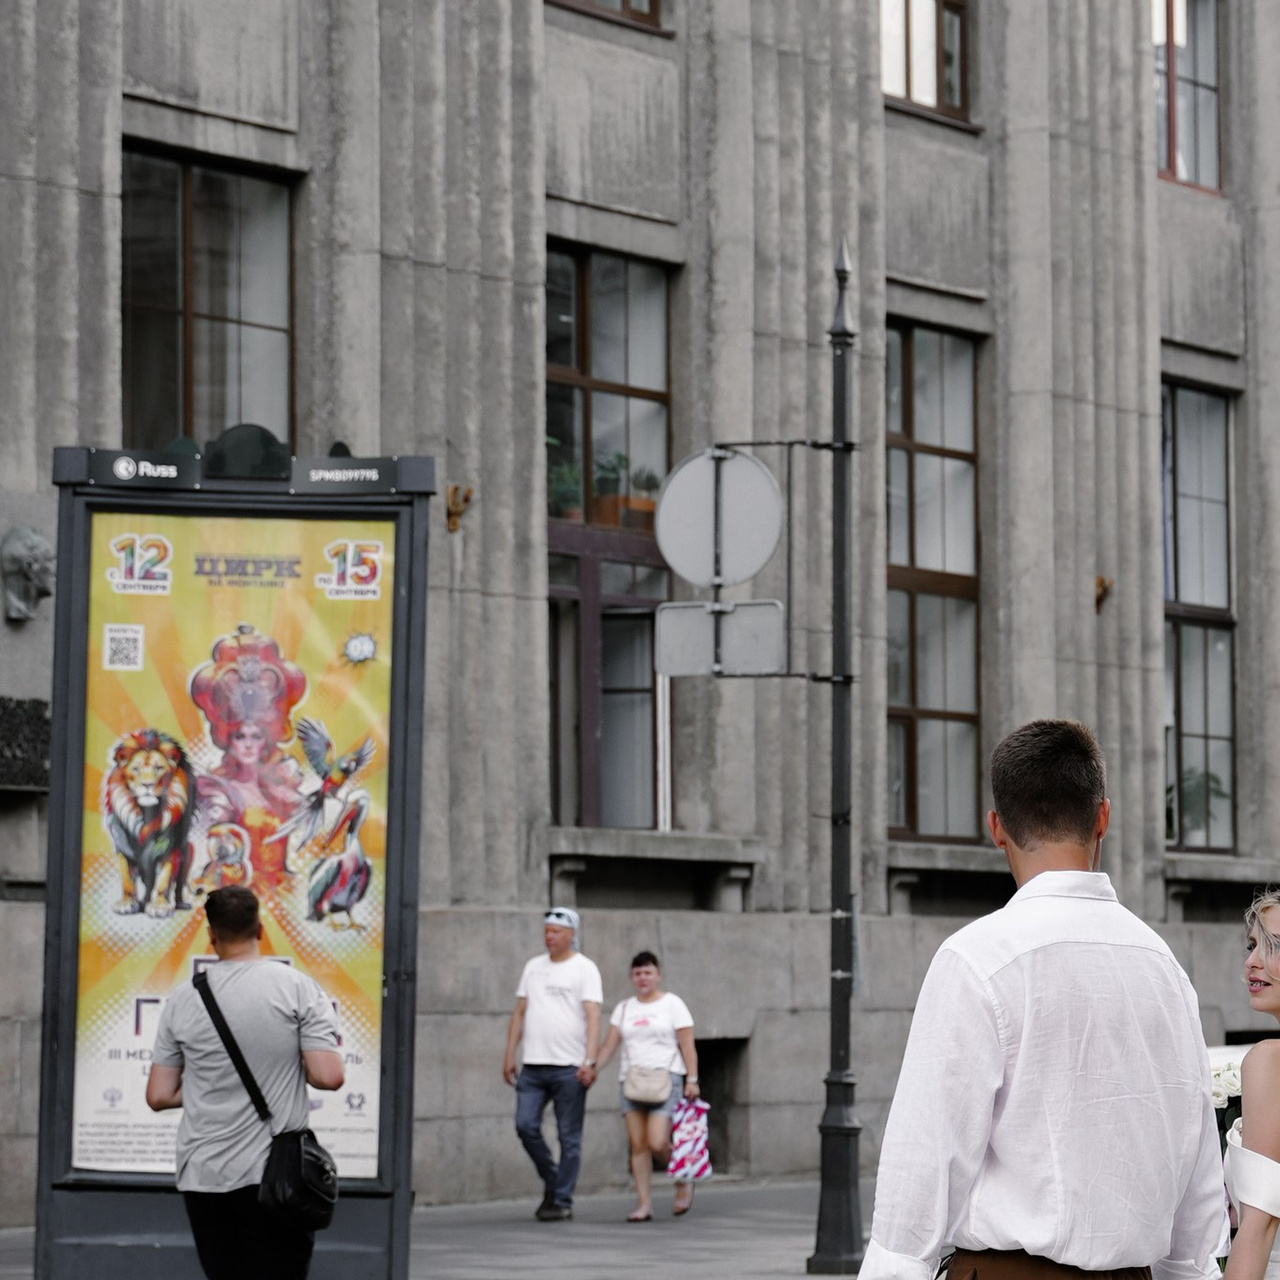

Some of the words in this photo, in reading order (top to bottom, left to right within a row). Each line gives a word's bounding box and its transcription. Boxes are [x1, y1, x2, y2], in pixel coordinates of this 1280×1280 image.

[138, 461, 177, 478] Russ
[115, 538, 168, 580] 12
[195, 556, 301, 580] ЦИРК
[328, 543, 379, 585] 15
[108, 1048, 121, 1060] III
